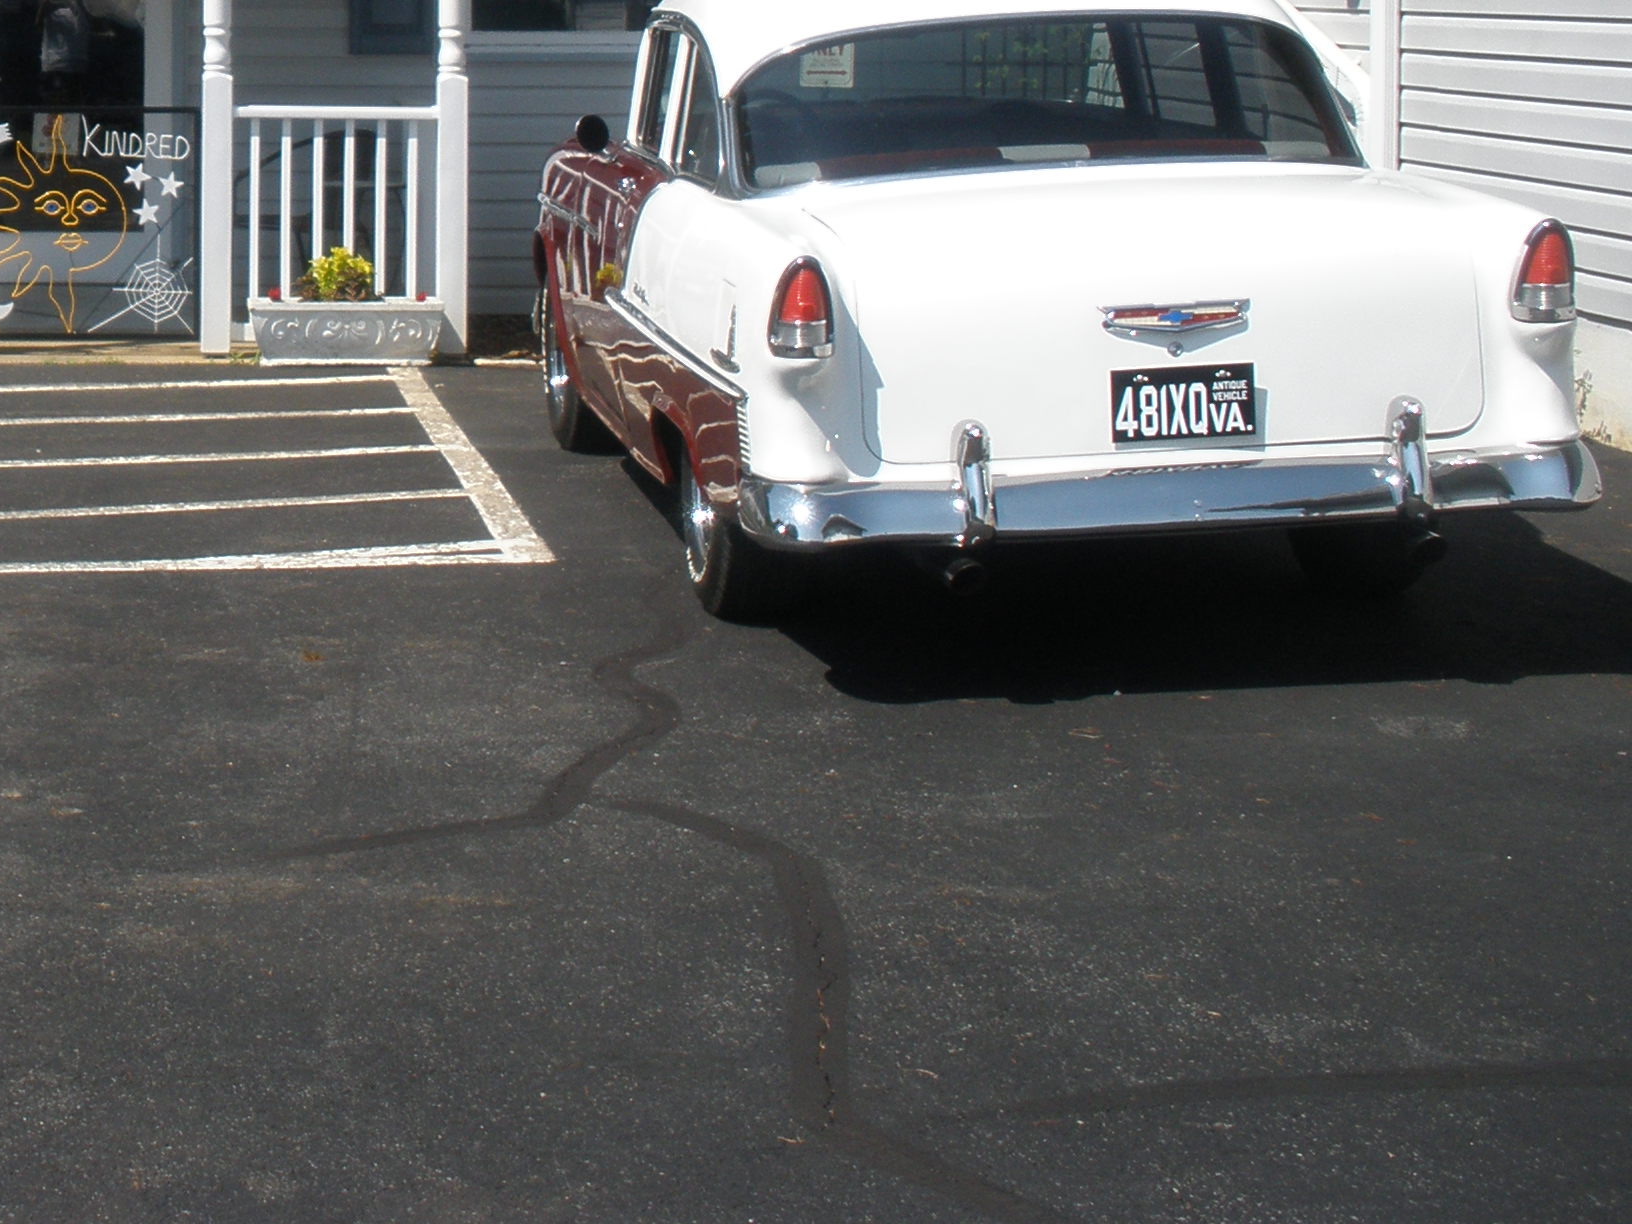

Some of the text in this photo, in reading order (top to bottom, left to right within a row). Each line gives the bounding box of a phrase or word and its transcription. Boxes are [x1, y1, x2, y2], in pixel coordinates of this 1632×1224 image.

[81, 114, 190, 160] KINDRED
[1212, 379, 1248, 390] ANTIQUE
[1212, 390, 1248, 401] VEHICLE
[1115, 382, 1208, 437] 481XQ
